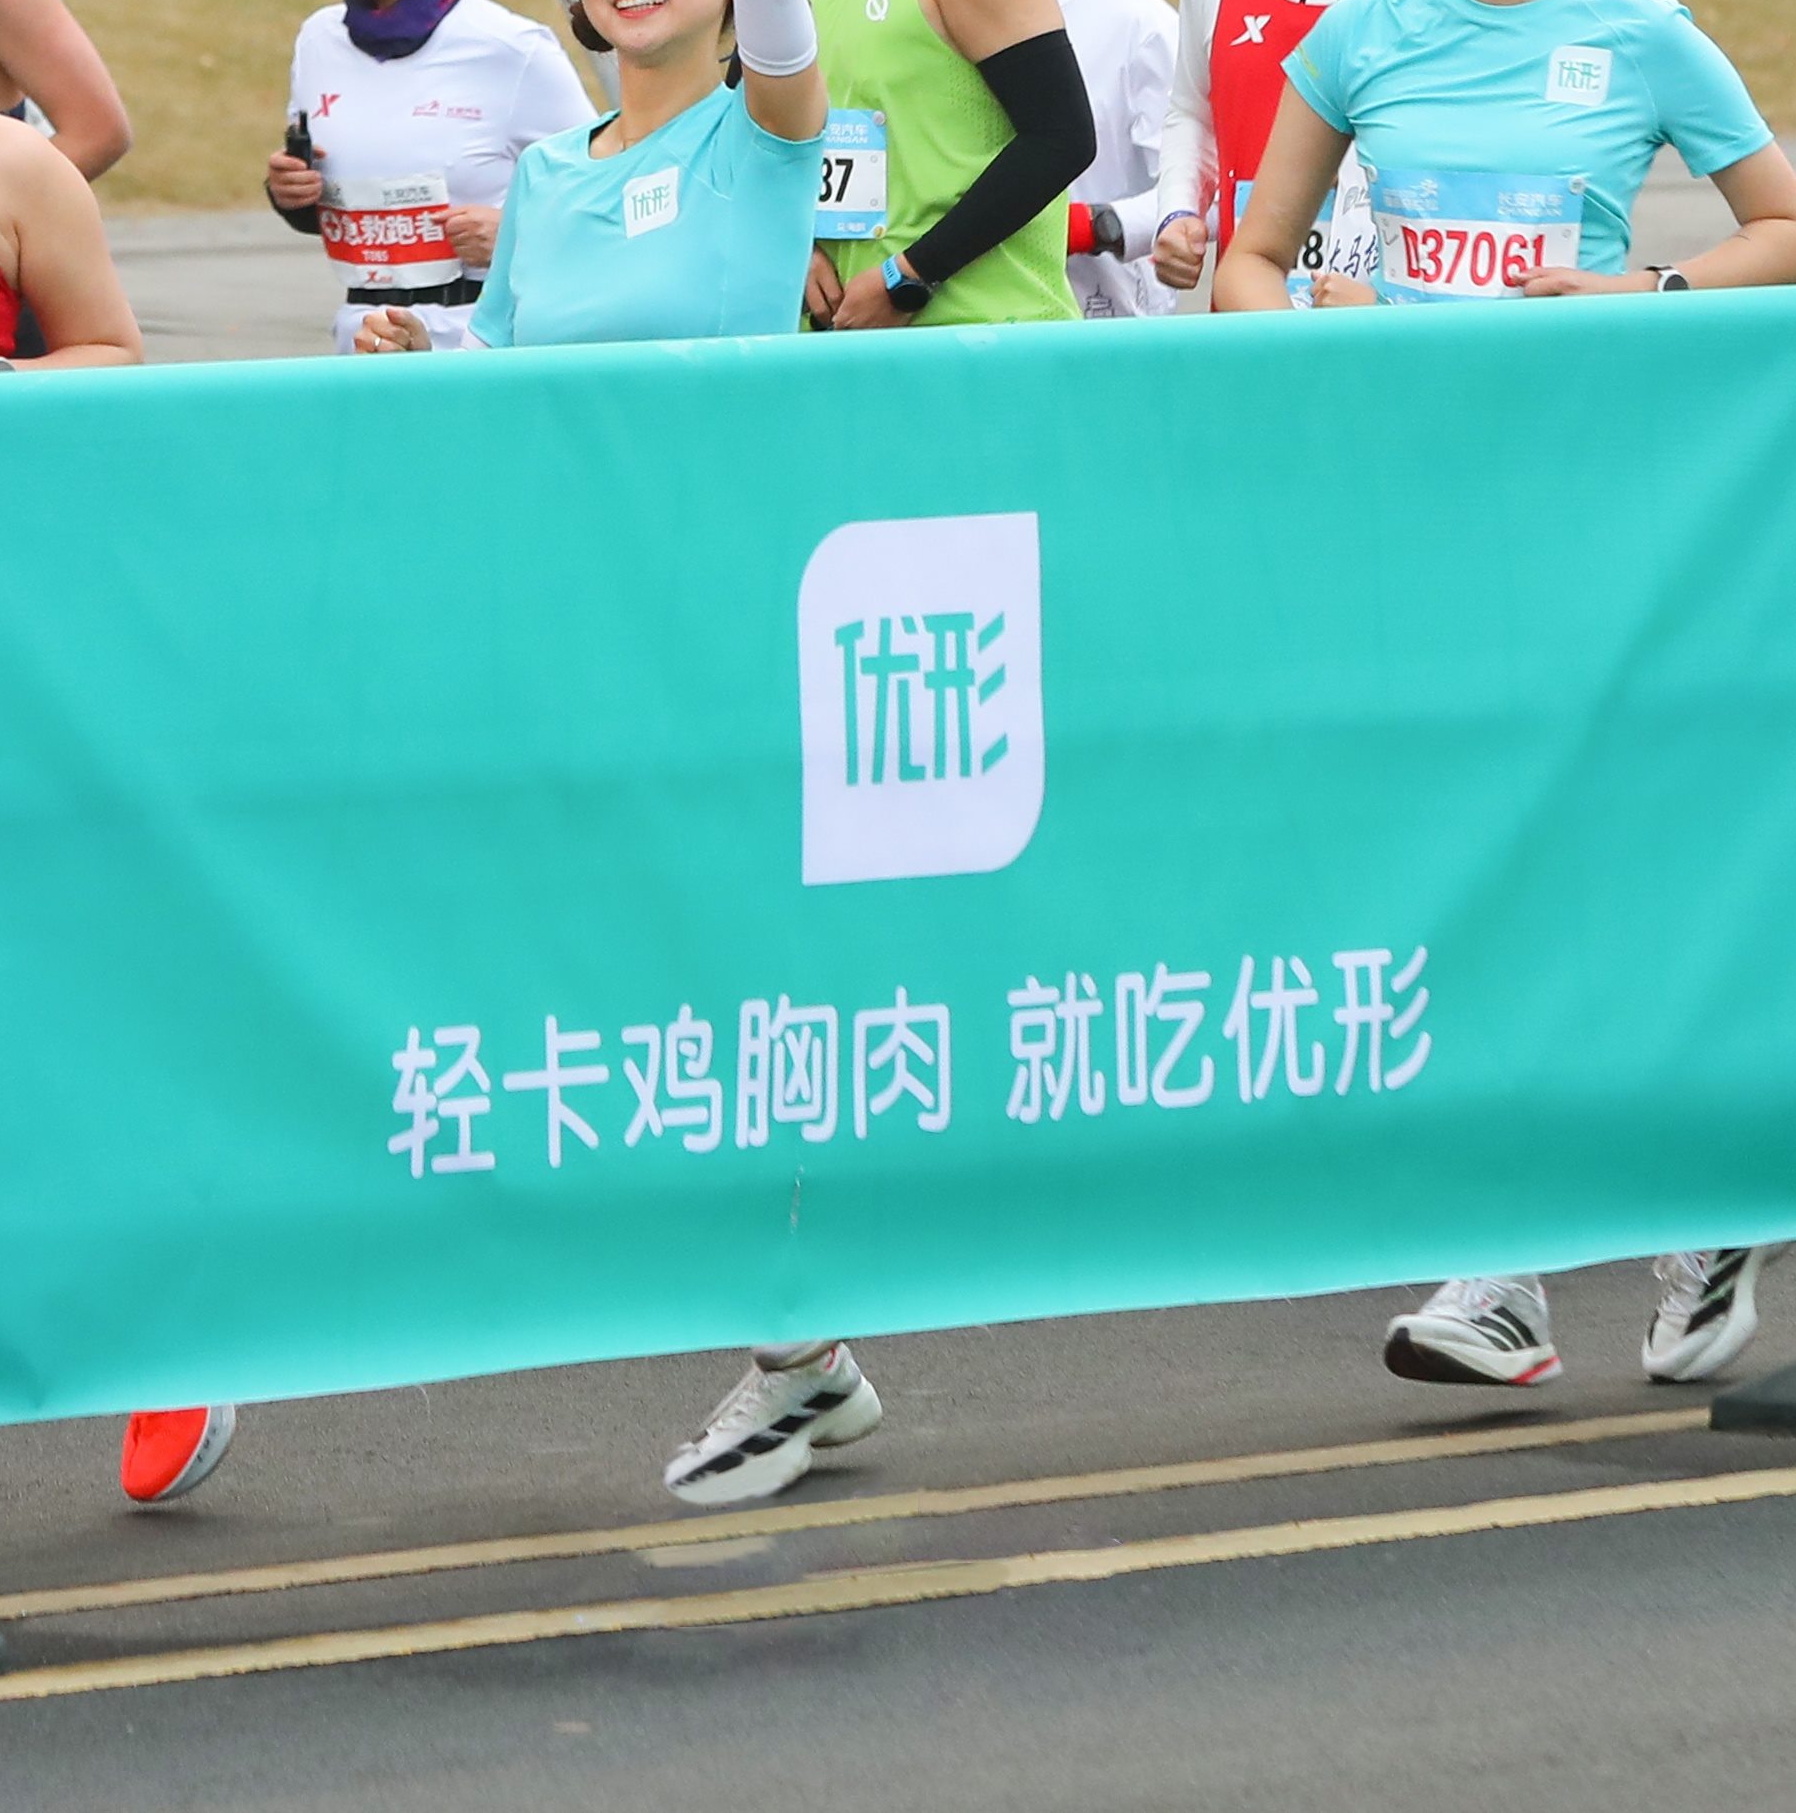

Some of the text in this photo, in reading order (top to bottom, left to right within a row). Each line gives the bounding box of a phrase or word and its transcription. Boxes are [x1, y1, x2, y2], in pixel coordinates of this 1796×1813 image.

[834, 611, 1009, 787] 优形
[386, 945, 1433, 1178] 轻卡鸡胸肉 就吃优形
